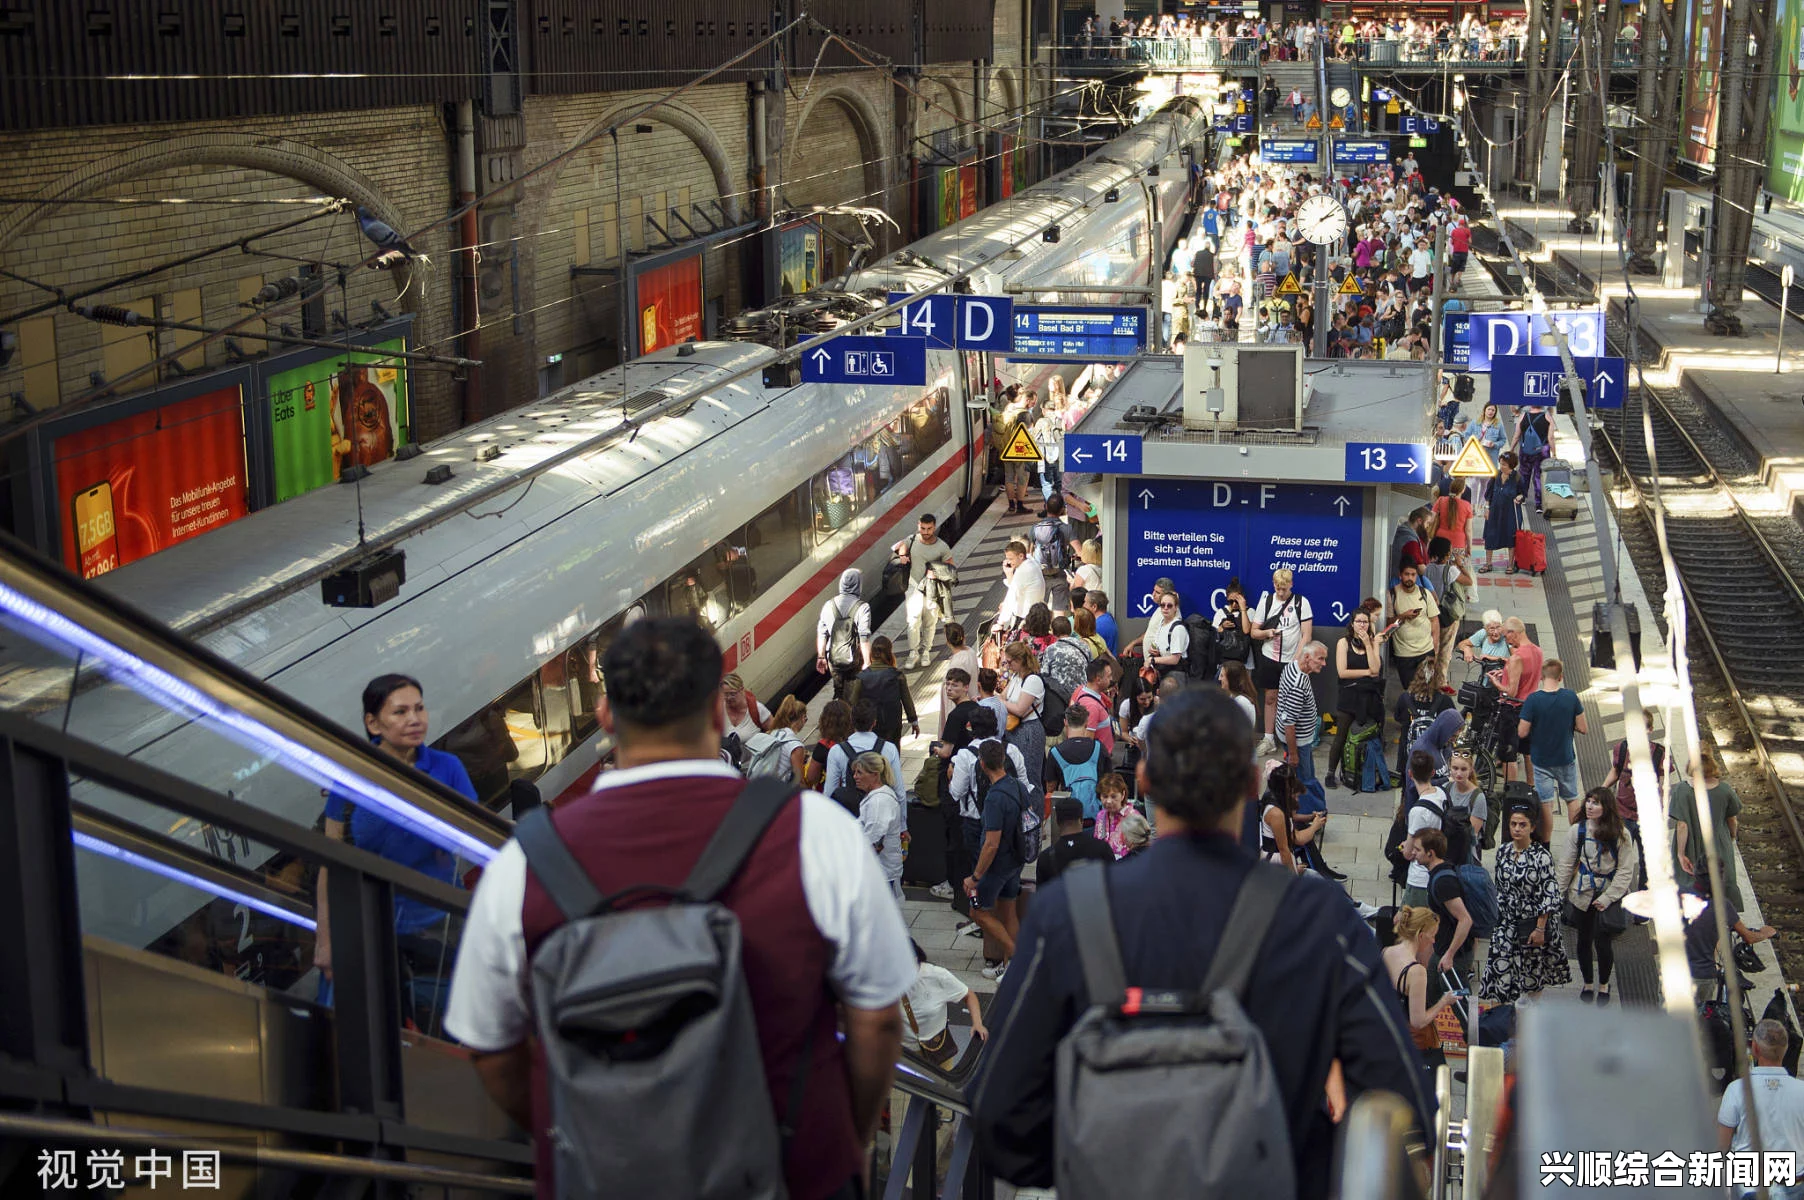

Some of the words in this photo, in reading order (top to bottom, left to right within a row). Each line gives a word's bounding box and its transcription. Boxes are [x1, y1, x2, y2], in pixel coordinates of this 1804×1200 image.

[1237, 116, 1246, 130] E
[1406, 118, 1415, 132] E
[901, 300, 936, 336] 14
[965, 301, 994, 342] D
[1014, 314, 1030, 328] 14
[1060, 324, 1074, 332] Bad
[1488, 318, 1519, 360] D
[273, 390, 294, 406] Uber
[274, 405, 294, 422] Eats
[1102, 440, 1128, 462] 14
[1360, 448, 1386, 471] 13
[170, 496, 182, 508] Das
[1213, 483, 1232, 508] D
[1261, 484, 1276, 509] F
[181, 504, 201, 520] unsere
[201, 497, 220, 511] treuen
[1144, 531, 1165, 540] Bitte
[1168, 532, 1207, 542] verteilen
[1210, 533, 1225, 542] Sie
[1270, 536, 1302, 546] Please
[1304, 538, 1321, 546] use
[1323, 538, 1339, 547] the
[1154, 544, 1173, 553] sich
[1176, 545, 1191, 554] auf
[1193, 546, 1213, 555] dem
[1275, 549, 1302, 558] entire
[1304, 550, 1334, 561] length
[1137, 558, 1182, 567] gesamten
[1184, 558, 1231, 570] Bahnsteig
[1270, 561, 1280, 570] of
[1282, 561, 1296, 570] the
[1298, 562, 1338, 573] platform
